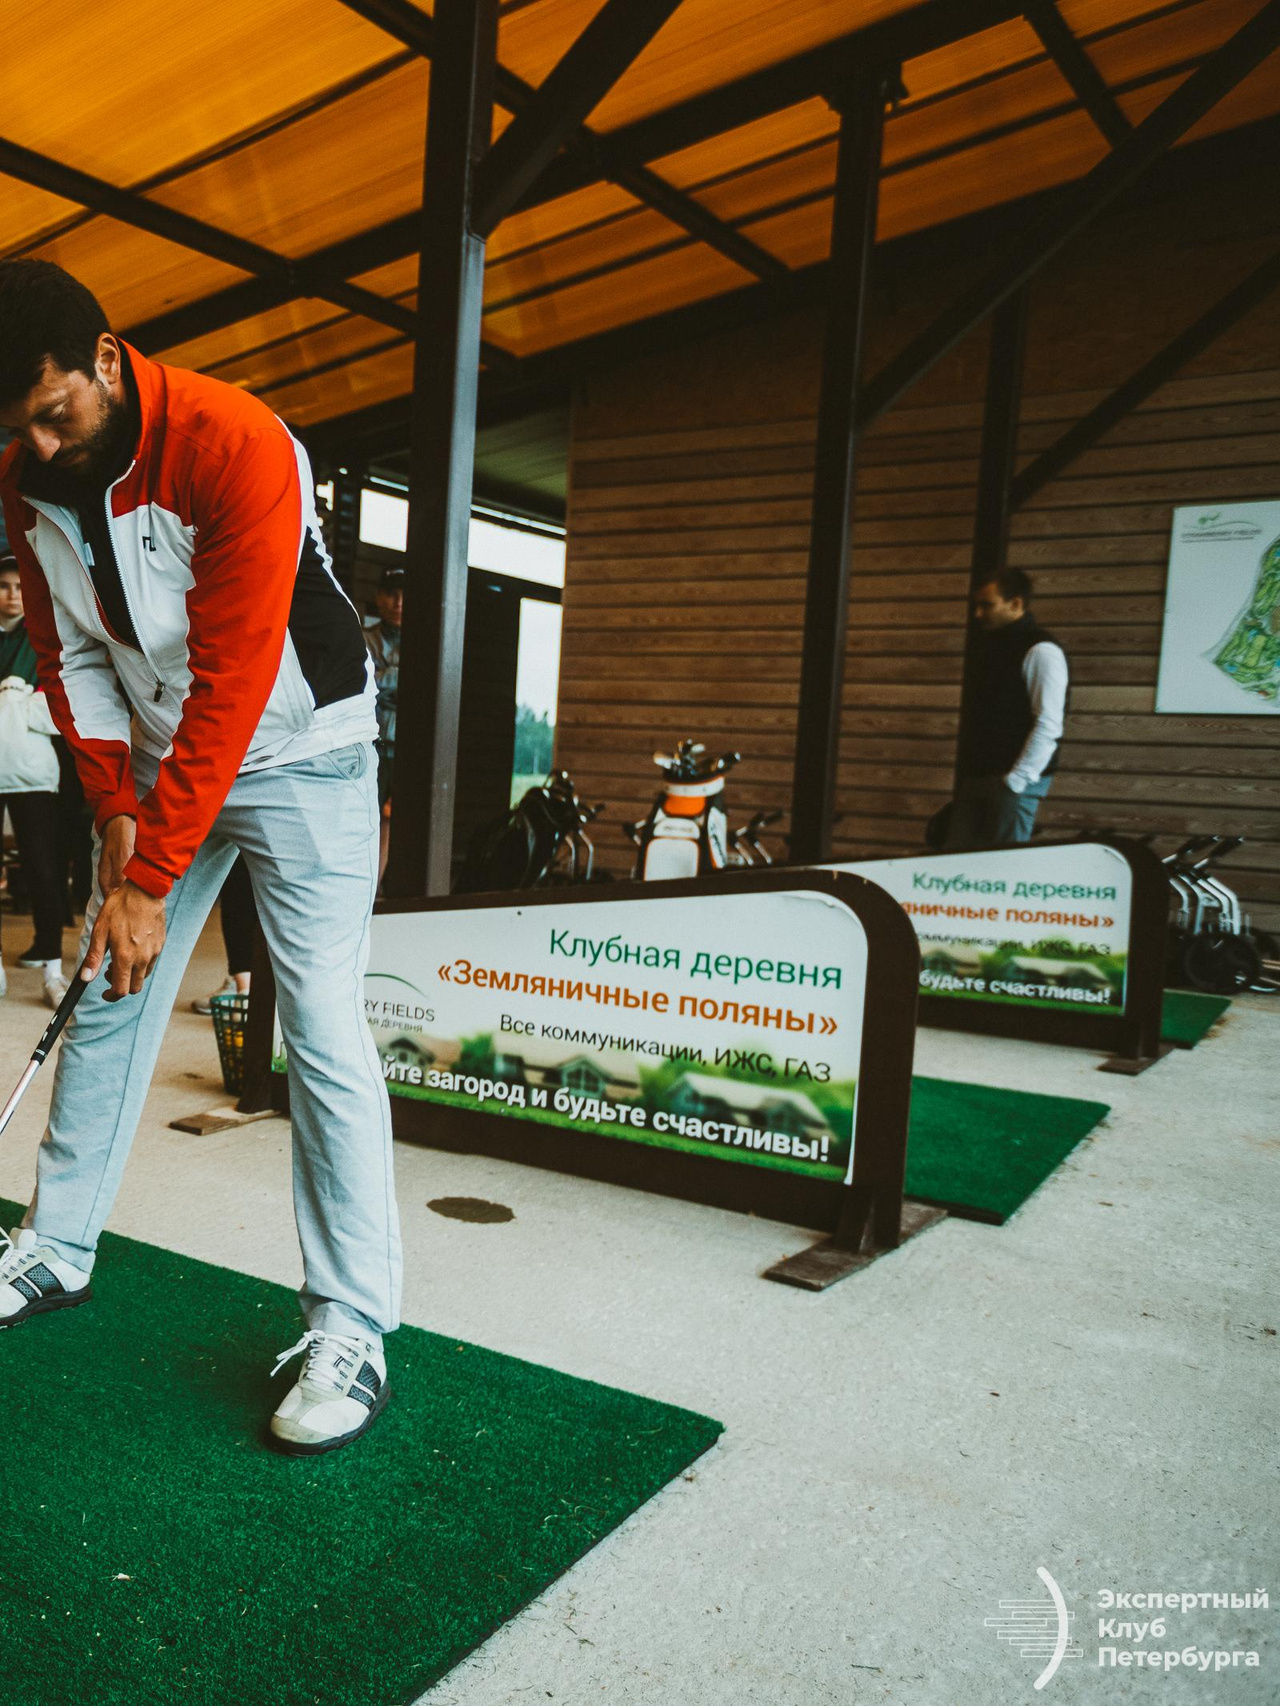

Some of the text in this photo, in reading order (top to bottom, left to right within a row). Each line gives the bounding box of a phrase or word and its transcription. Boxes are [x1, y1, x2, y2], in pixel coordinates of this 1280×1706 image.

[912, 871, 1117, 901] Клубная деревня
[1005, 908, 1115, 928] поляны»
[549, 928, 842, 990] Клубная деревня
[437, 959, 839, 1035] «Земляничные поляны»
[918, 968, 1112, 1005] будьте счастливы!
[380, 1017, 423, 1033] ДЕРЕВНЯ
[382, 1001, 435, 1022] FIELDS
[500, 1013, 831, 1083] Все коммуникации, ИЖС, ГАЗ
[382, 1054, 830, 1163] йте загород и будьте счастливы!
